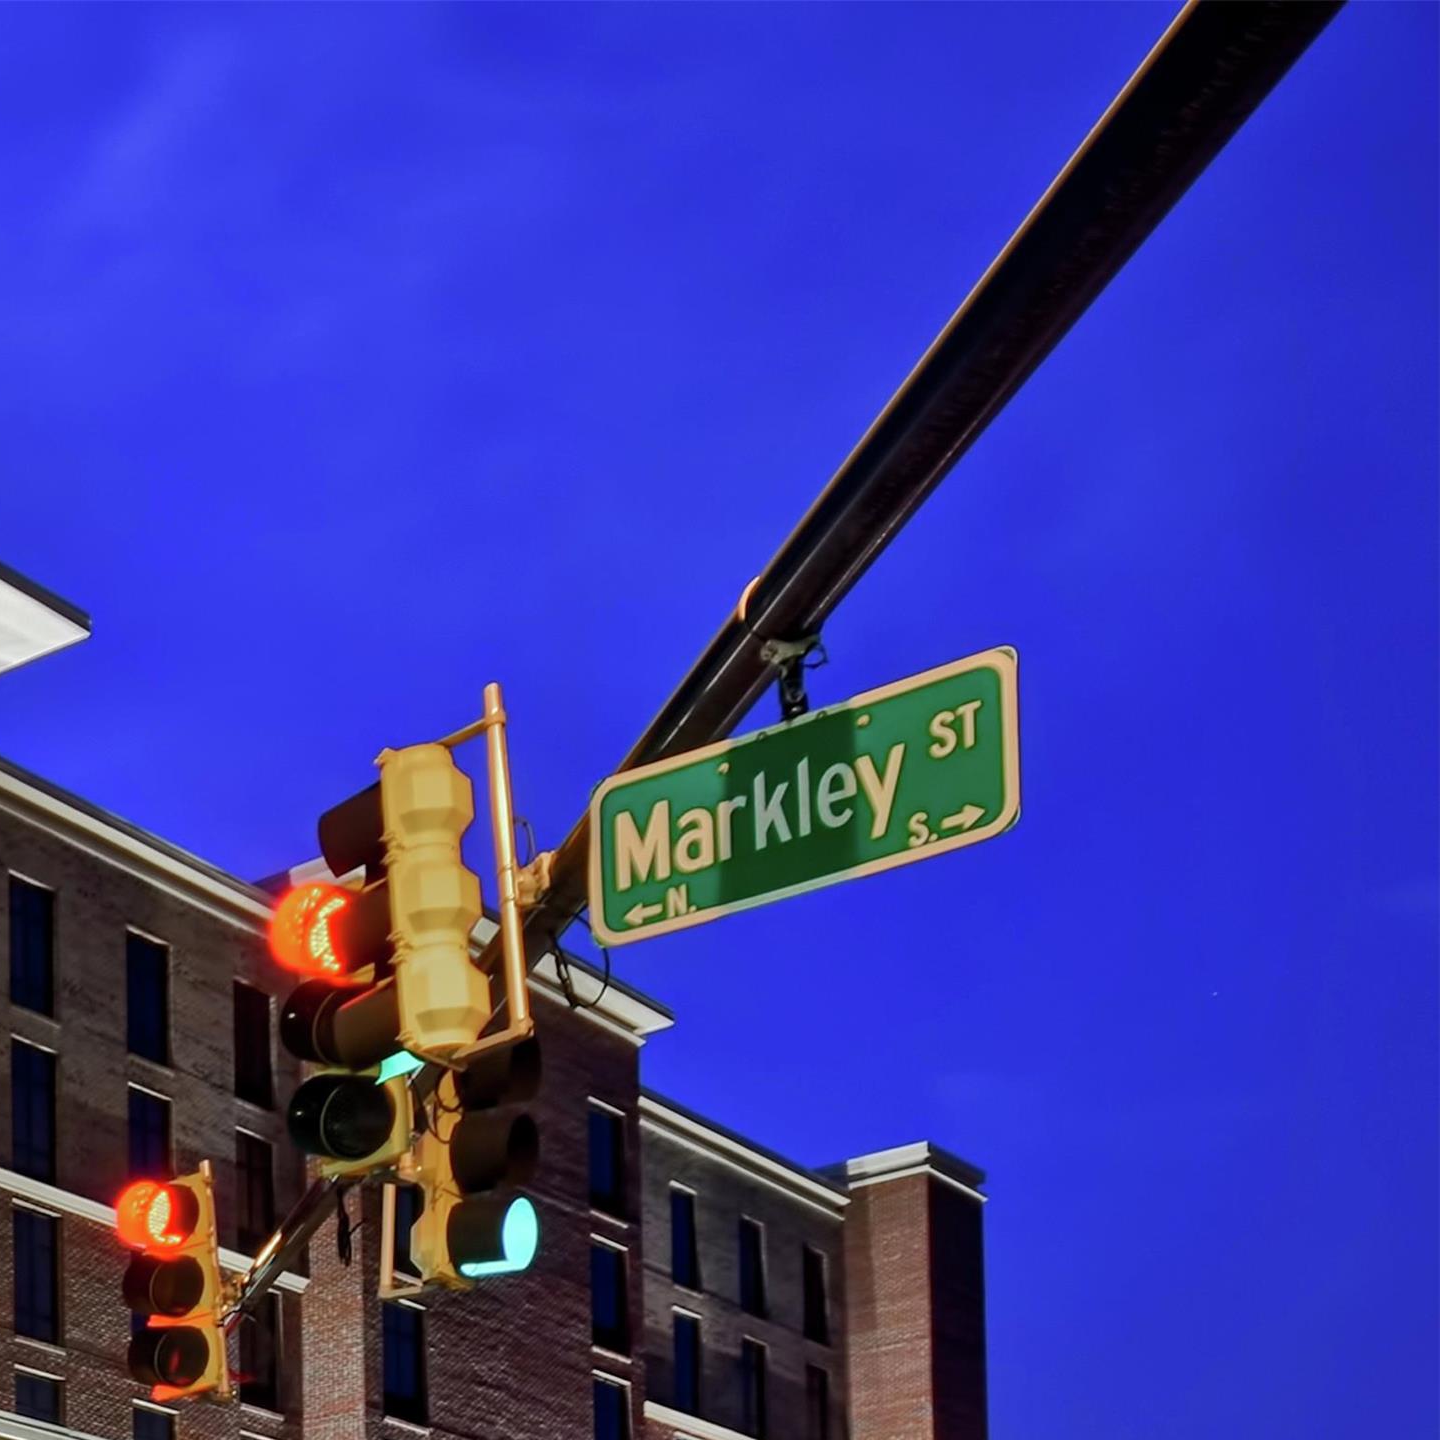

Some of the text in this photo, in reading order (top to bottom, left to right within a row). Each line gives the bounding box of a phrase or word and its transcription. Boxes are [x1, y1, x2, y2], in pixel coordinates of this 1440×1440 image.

[614, 700, 984, 892] Markley ST
[908, 811, 939, 848] S.
[666, 883, 698, 919] N.
